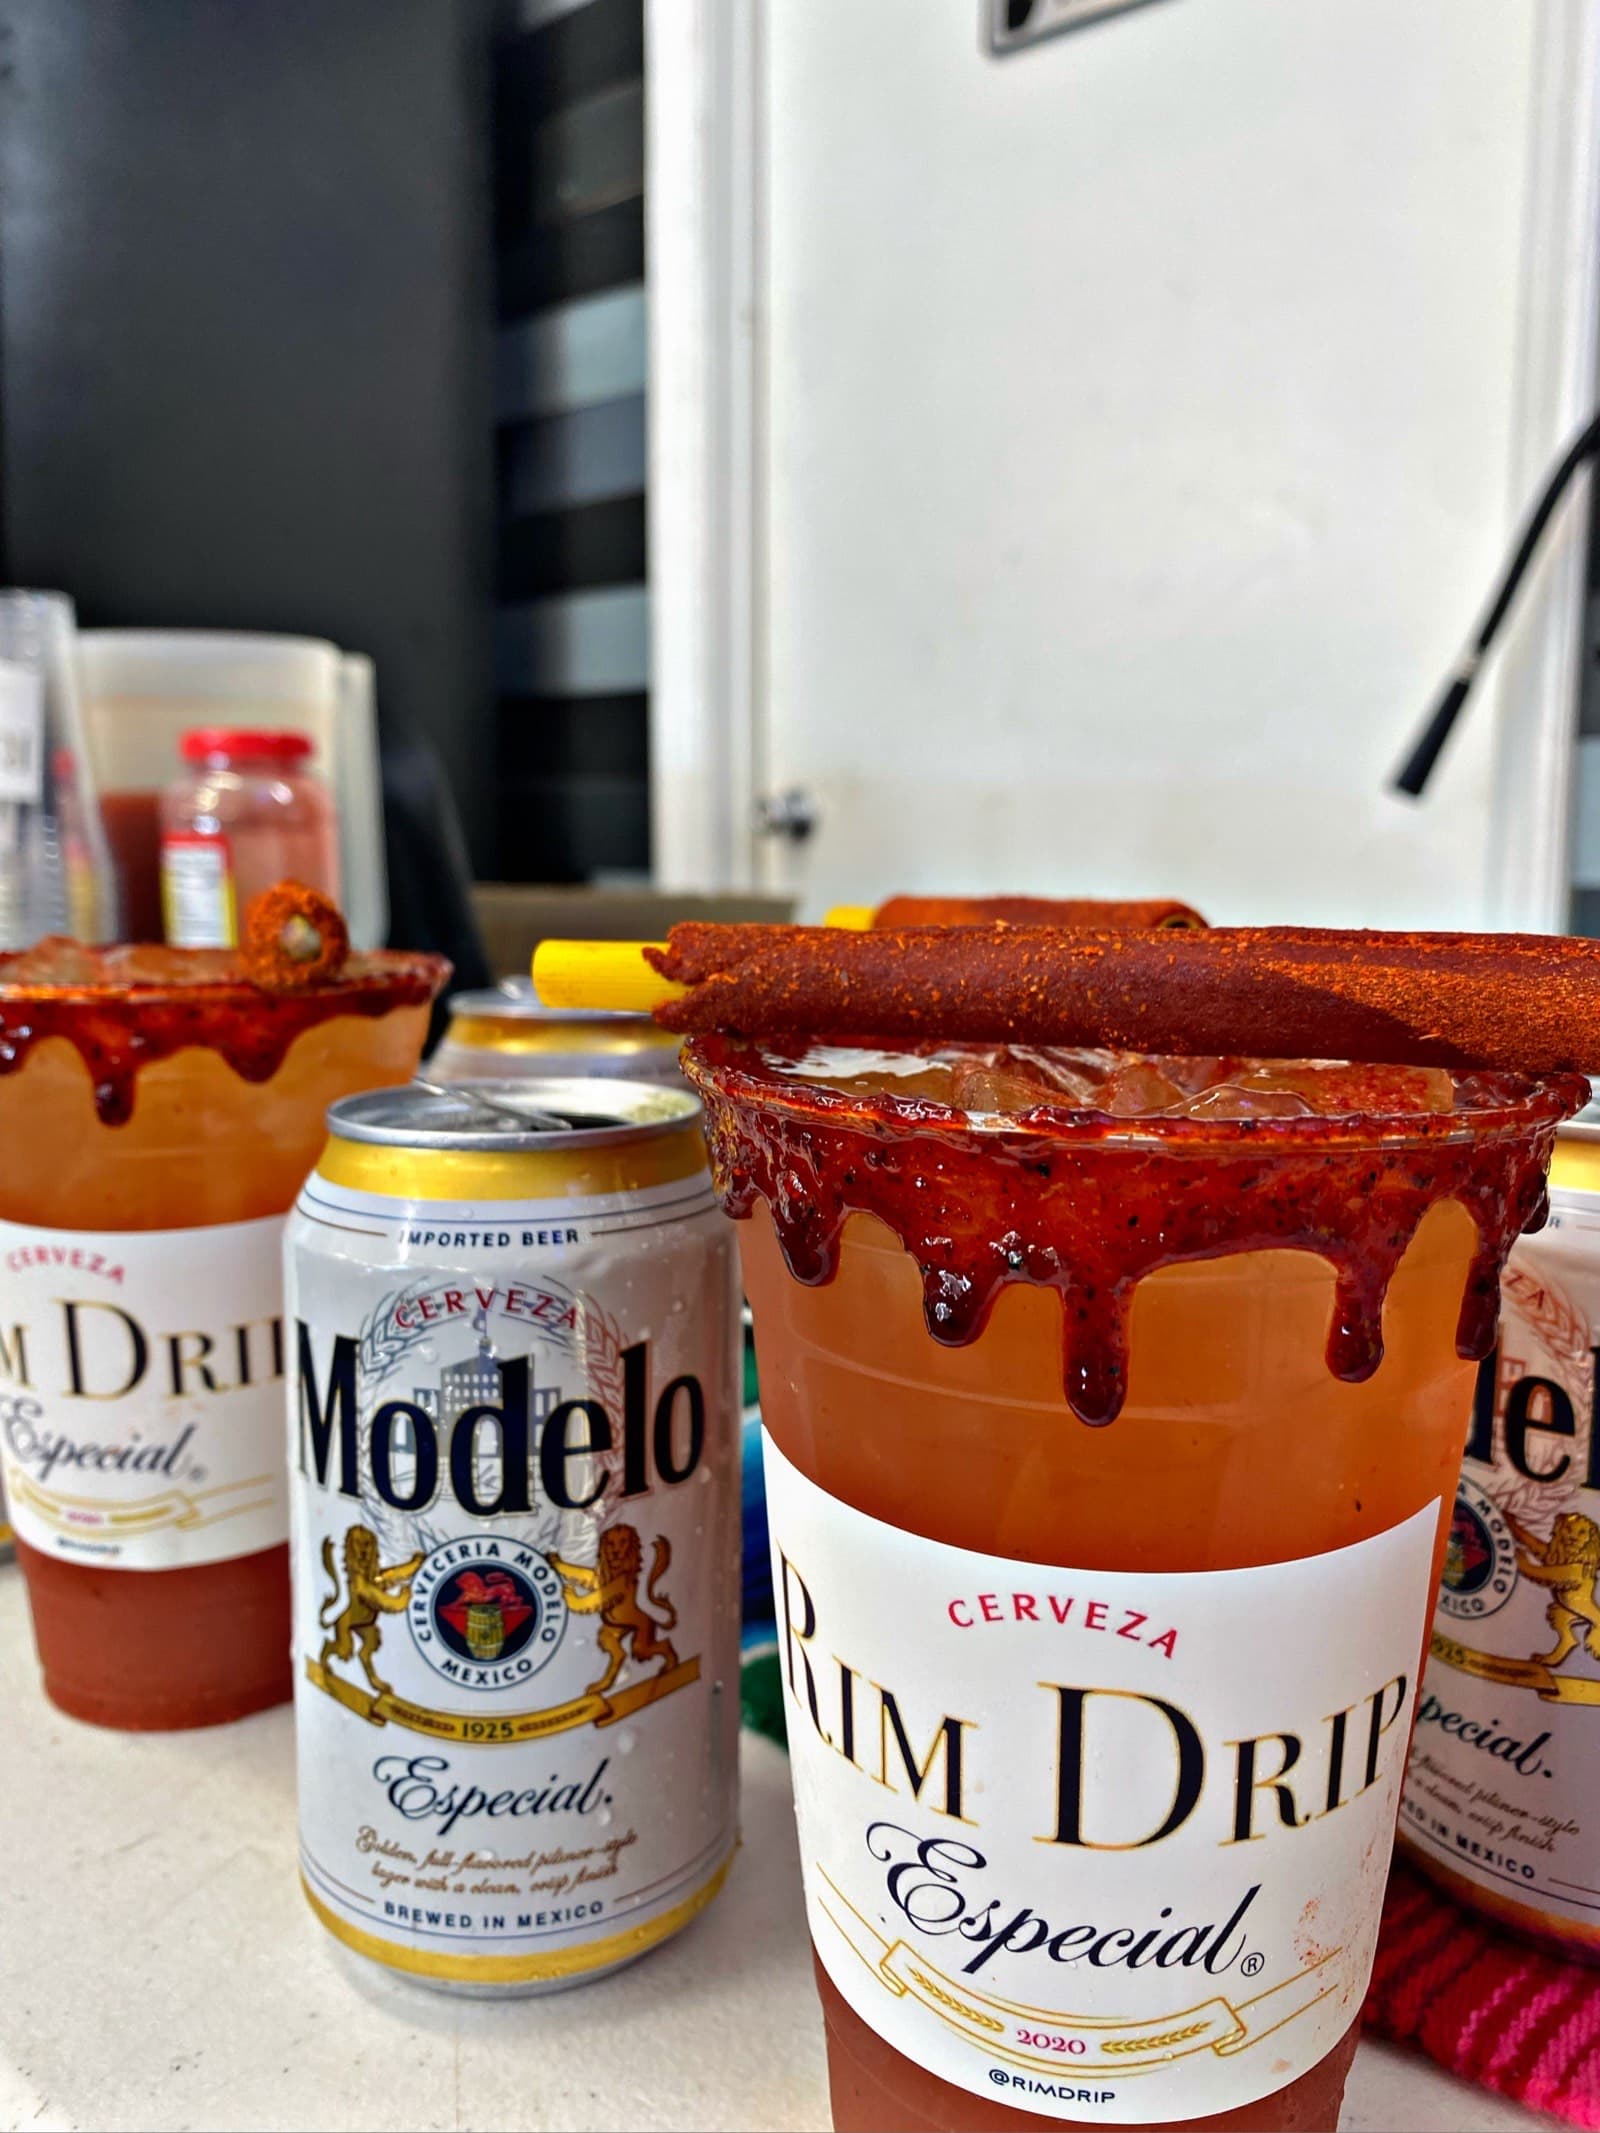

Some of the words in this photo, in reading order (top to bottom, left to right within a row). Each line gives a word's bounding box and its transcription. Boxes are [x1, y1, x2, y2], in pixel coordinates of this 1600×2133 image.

[400, 1230, 511, 1248] IMPORTED
[521, 1227, 580, 1248] BEER
[5, 1244, 126, 1286] CERVEZA
[394, 1286, 579, 1330] CERVEZA
[295, 1316, 706, 1517] Modelo
[412, 1541, 501, 1643] CERVECERIA
[513, 1550, 562, 1643] MODELO
[947, 1592, 1181, 1661] CERVEZA
[440, 1657, 533, 1686] MEXICO
[776, 1539, 980, 1828] RIM
[1031, 1674, 1408, 1852] DRIP
[461, 1721, 514, 1740] 1925
[1455, 1831, 1536, 1880] MEXICO
[384, 1900, 473, 1929] BREWED
[483, 1914, 505, 1929] IN
[516, 1900, 605, 1929] MEXICO
[1016, 2028, 1087, 2056] 2020
[987, 2068, 1117, 2104] @RIMDRIP
